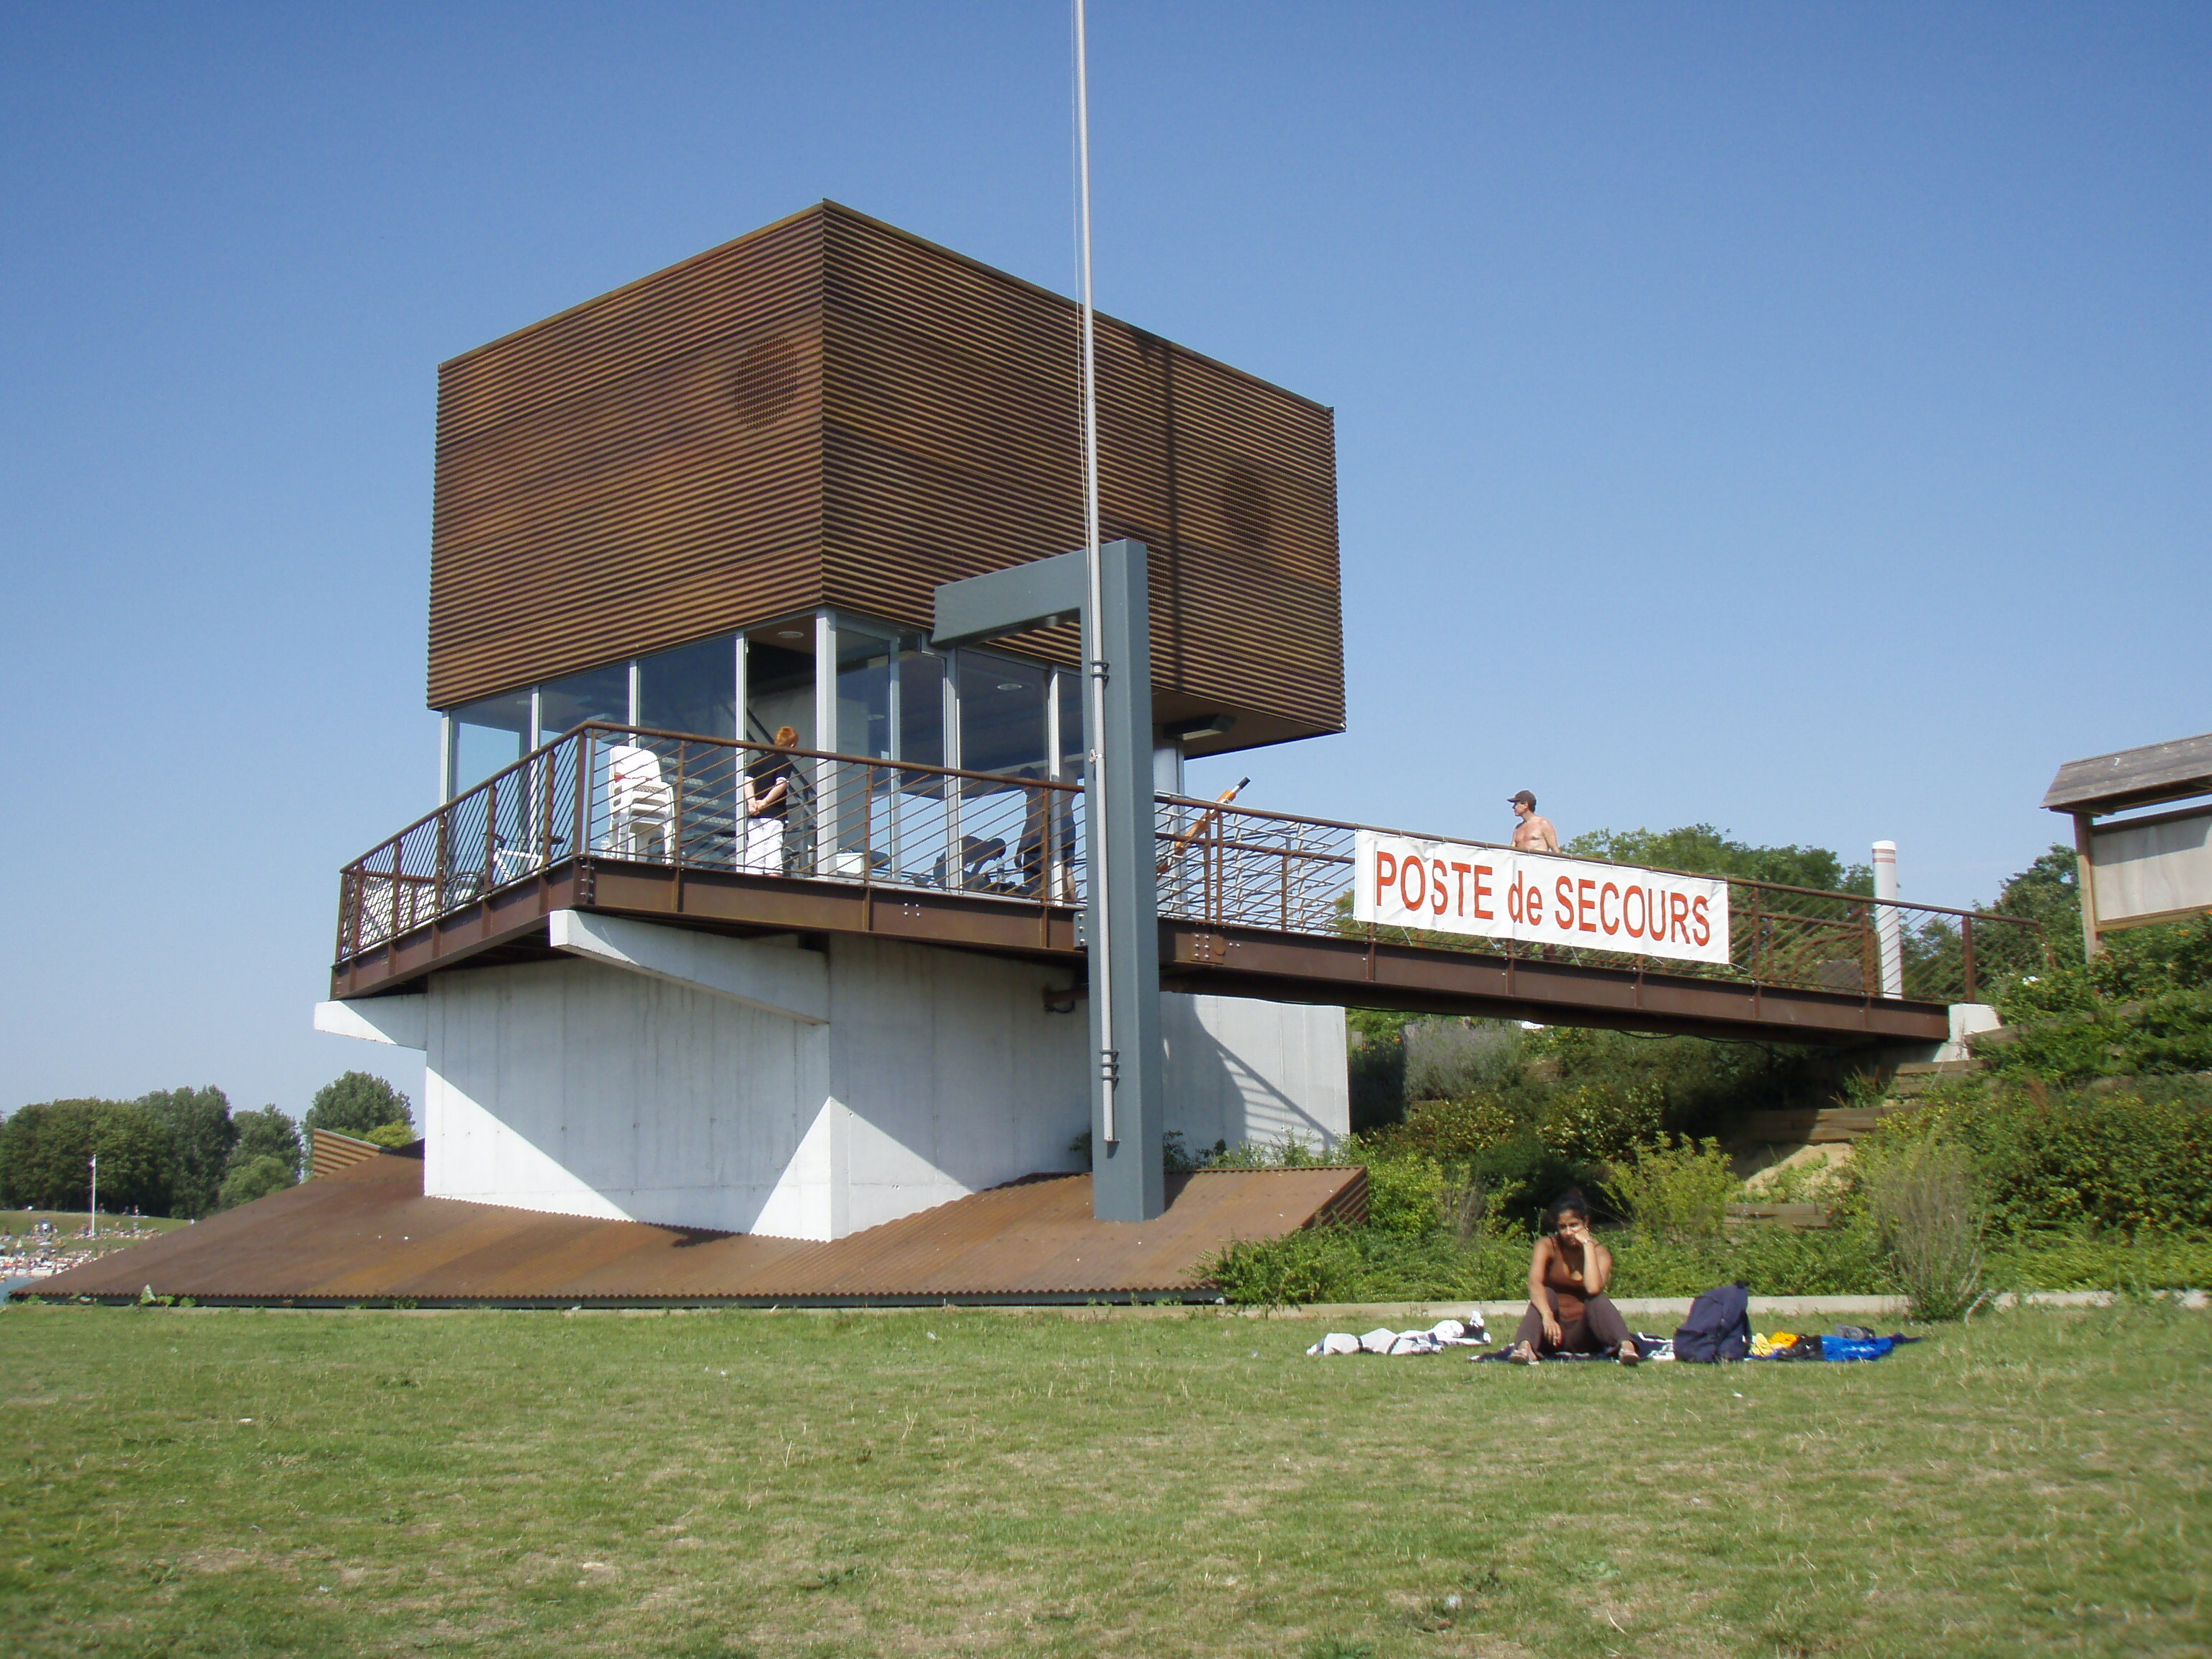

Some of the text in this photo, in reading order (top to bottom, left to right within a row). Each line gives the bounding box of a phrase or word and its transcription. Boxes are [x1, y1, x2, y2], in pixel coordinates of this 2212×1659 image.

[1376, 851, 1710, 946] POSTE de SECOURS
